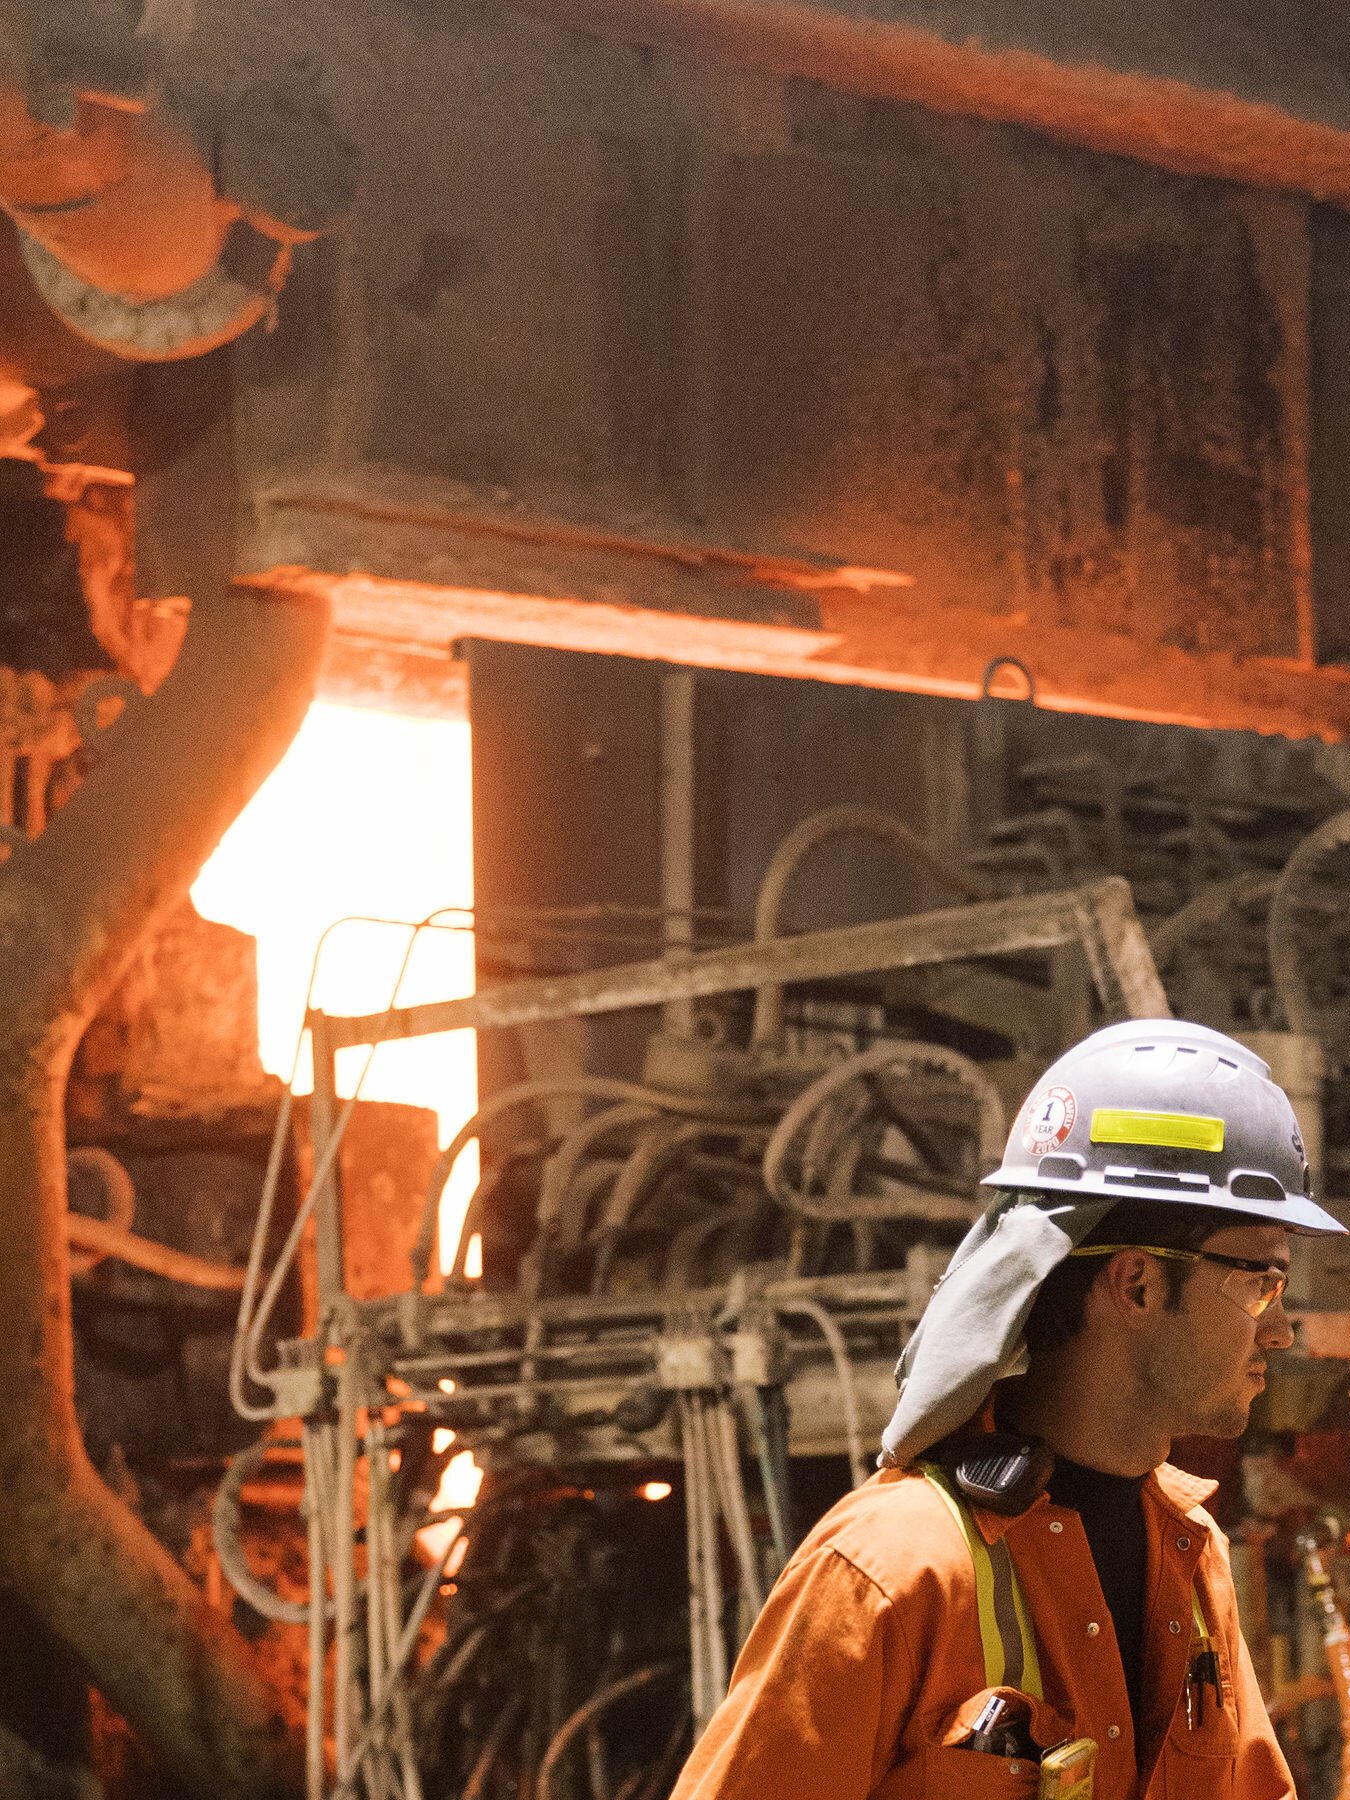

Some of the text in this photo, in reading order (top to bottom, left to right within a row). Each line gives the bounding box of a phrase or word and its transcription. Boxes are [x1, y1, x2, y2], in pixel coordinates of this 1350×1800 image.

[1042, 1101, 1055, 1121] 1
[1035, 1124, 1054, 1135] YEAR
[1035, 1136, 1060, 1153] 2020
